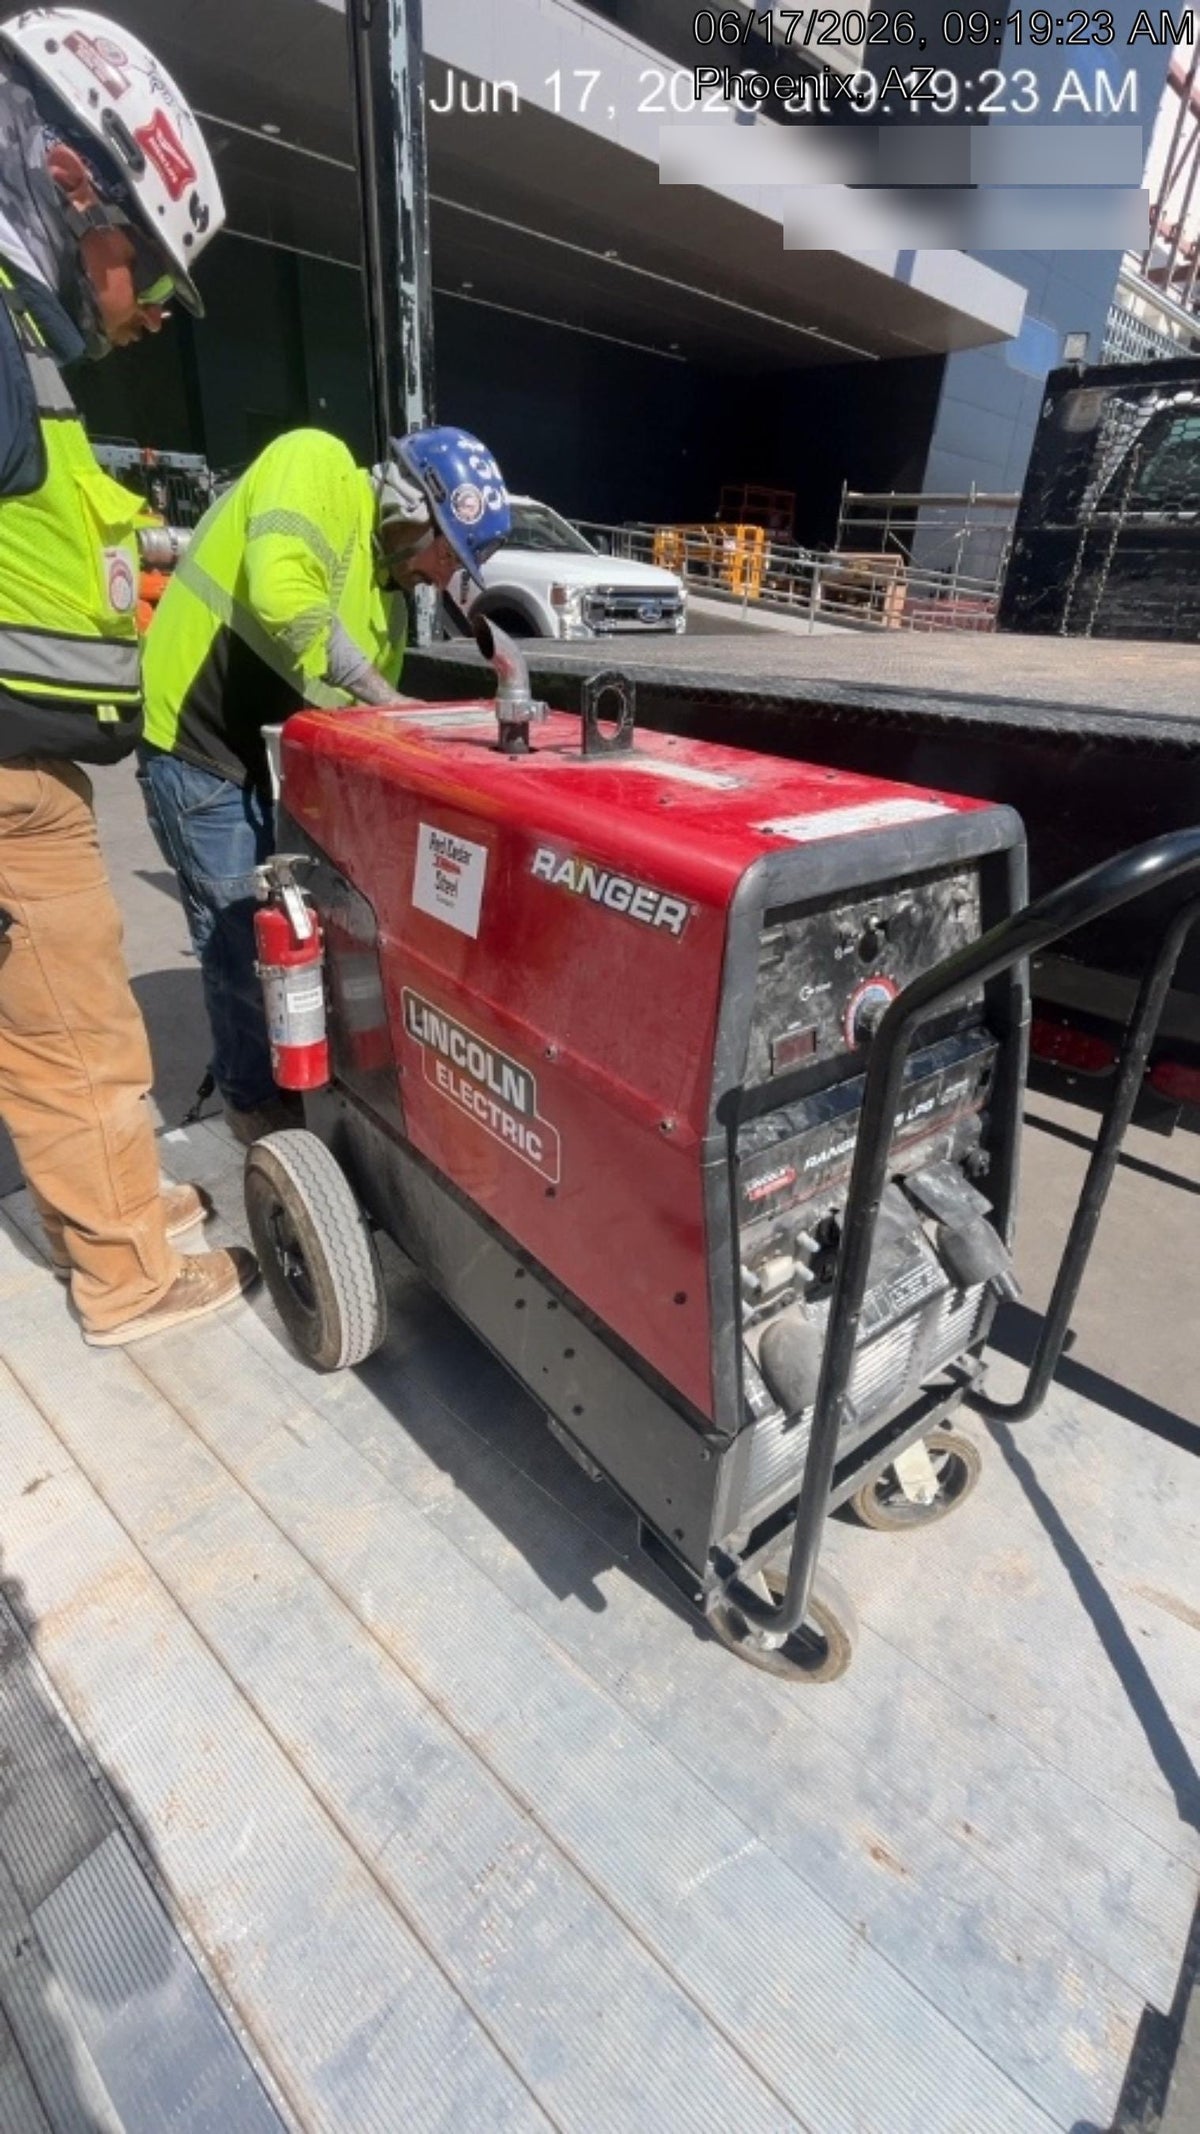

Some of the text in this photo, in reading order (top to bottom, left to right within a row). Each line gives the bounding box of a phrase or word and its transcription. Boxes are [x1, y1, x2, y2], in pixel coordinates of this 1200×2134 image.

[531, 848, 689, 935] RANGER
[409, 999, 527, 1113] LINCOLN
[435, 1058, 543, 1162] ELECTRIC
